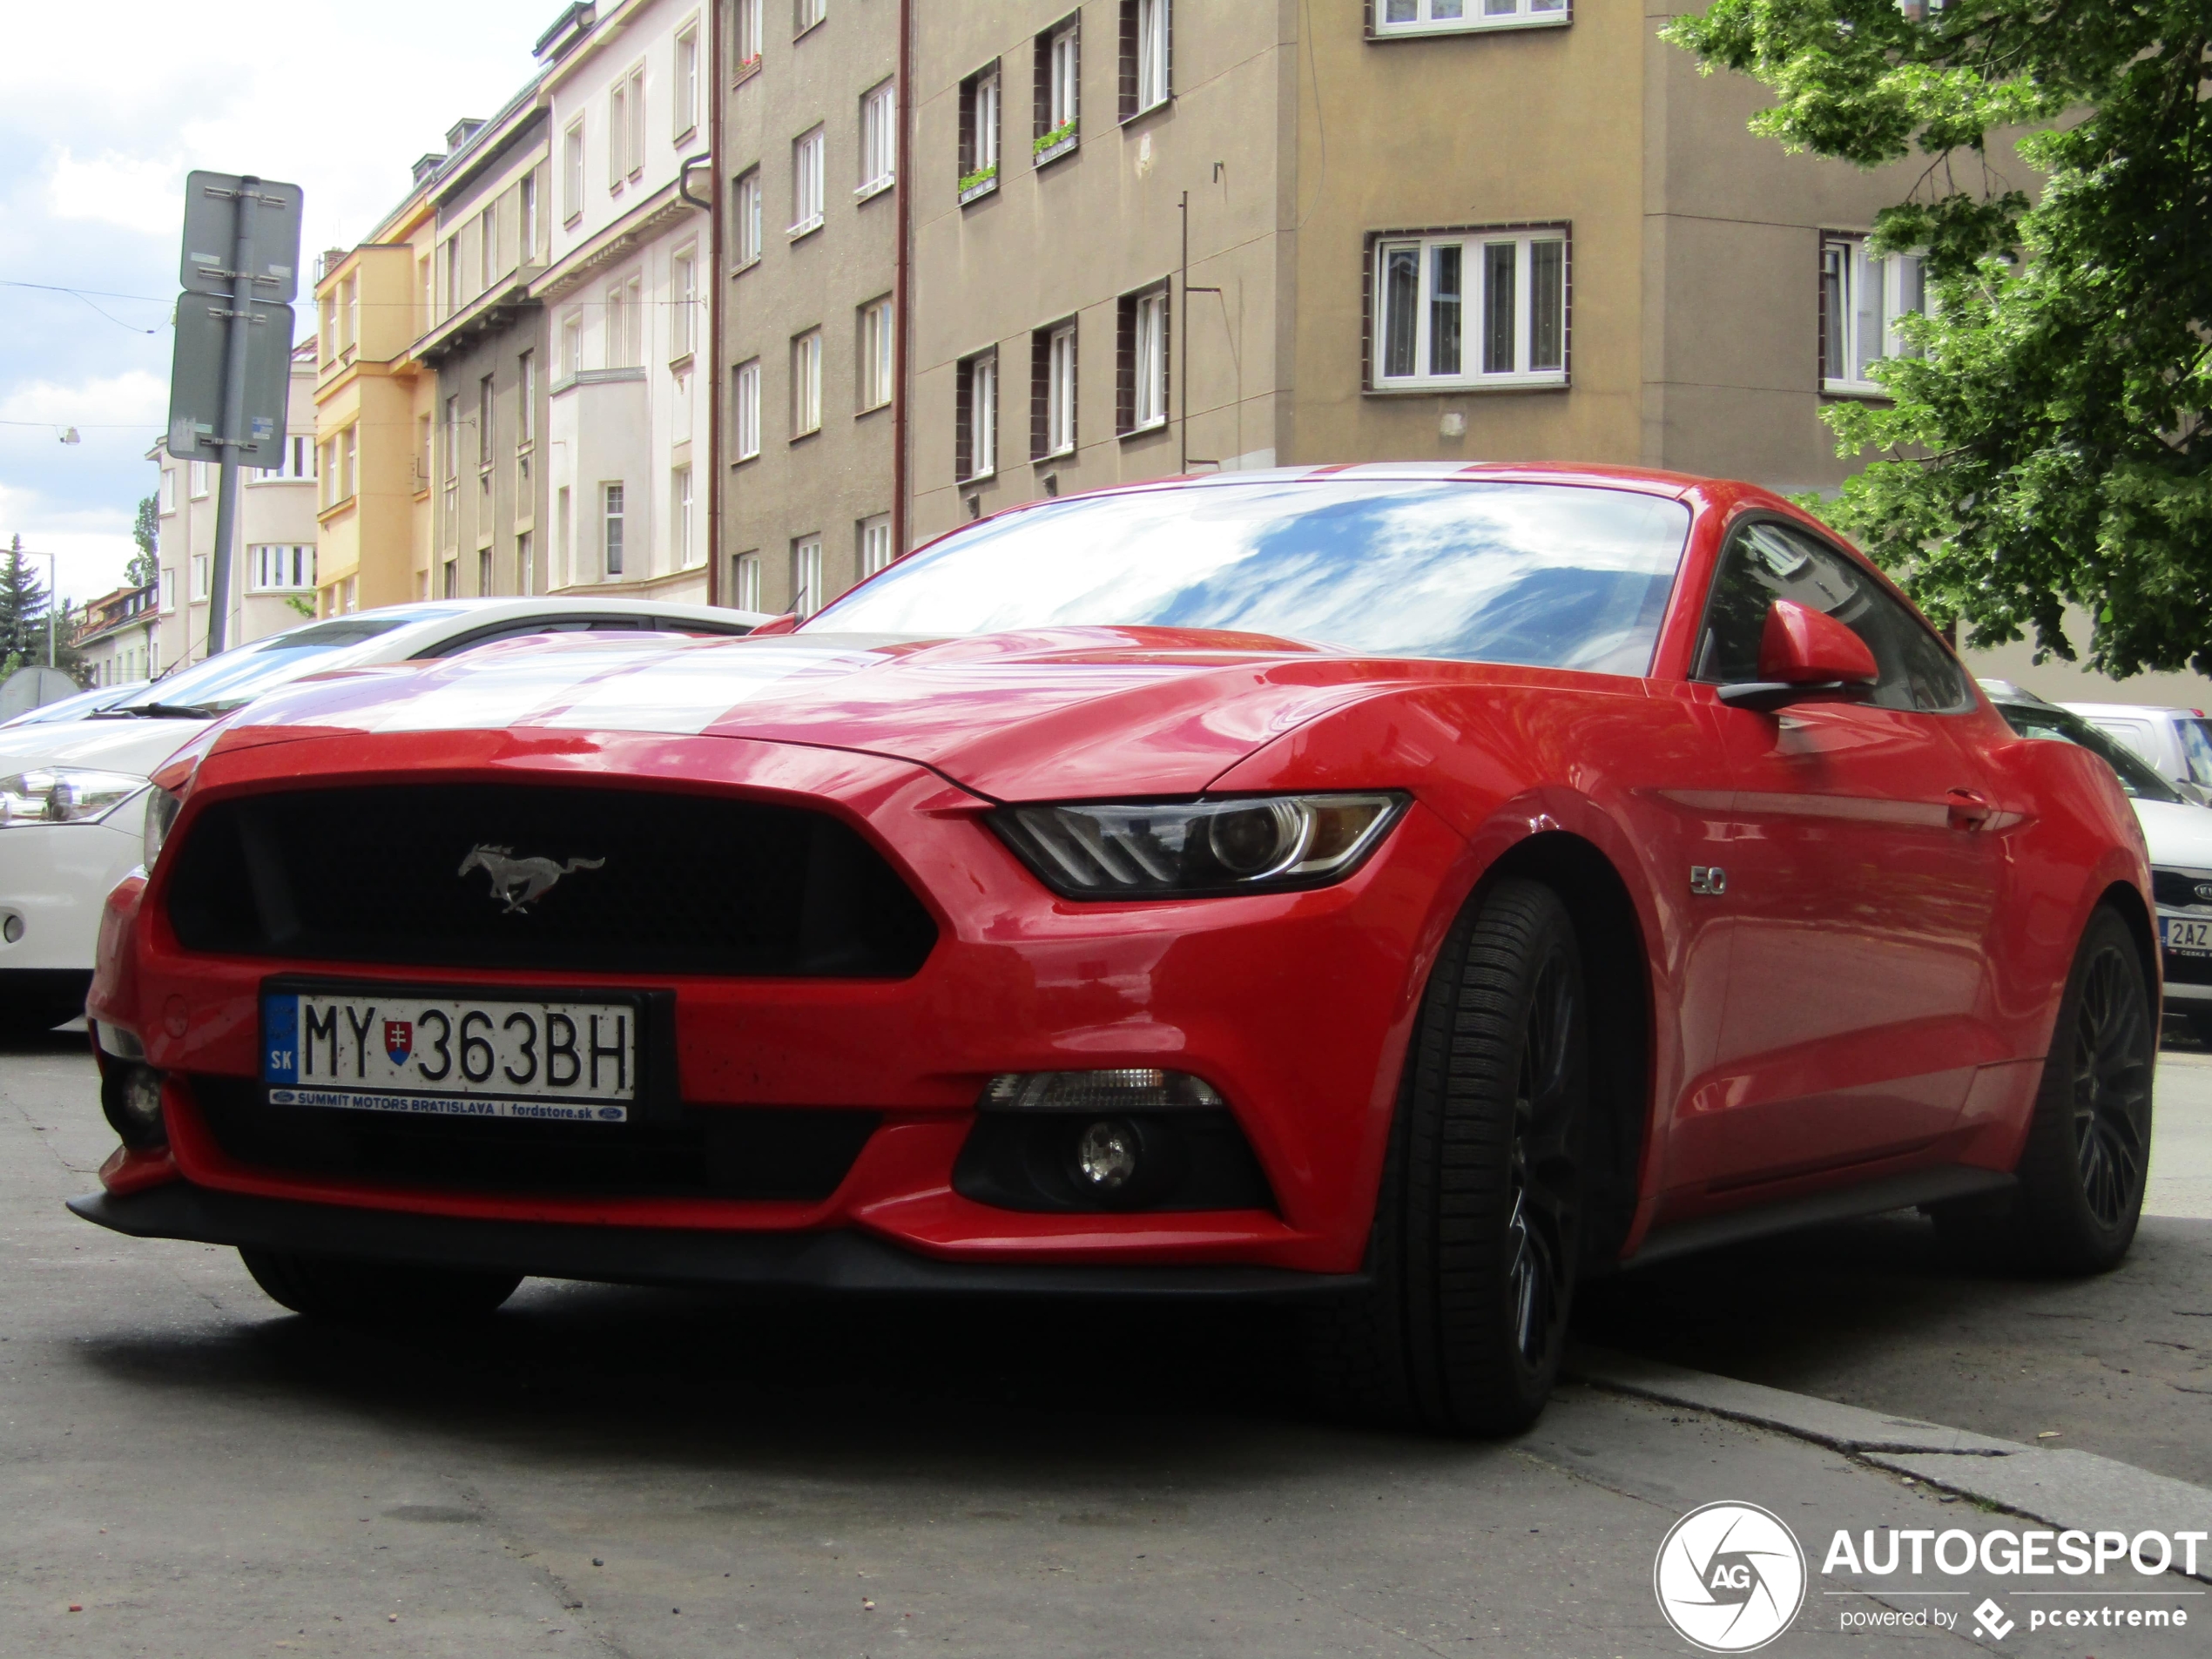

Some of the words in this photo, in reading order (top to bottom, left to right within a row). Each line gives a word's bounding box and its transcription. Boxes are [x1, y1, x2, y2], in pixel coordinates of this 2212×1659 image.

[2173, 923, 2207, 947] 2AZ
[305, 1004, 376, 1078] MY
[417, 1008, 626, 1089] 363BH
[271, 1050, 292, 1070] SK
[299, 1093, 349, 1106] SUMMIT
[353, 1096, 408, 1110] MOTORS
[411, 1100, 494, 1115] BRATISLAVA
[512, 1103, 592, 1119] fordstore.sk
